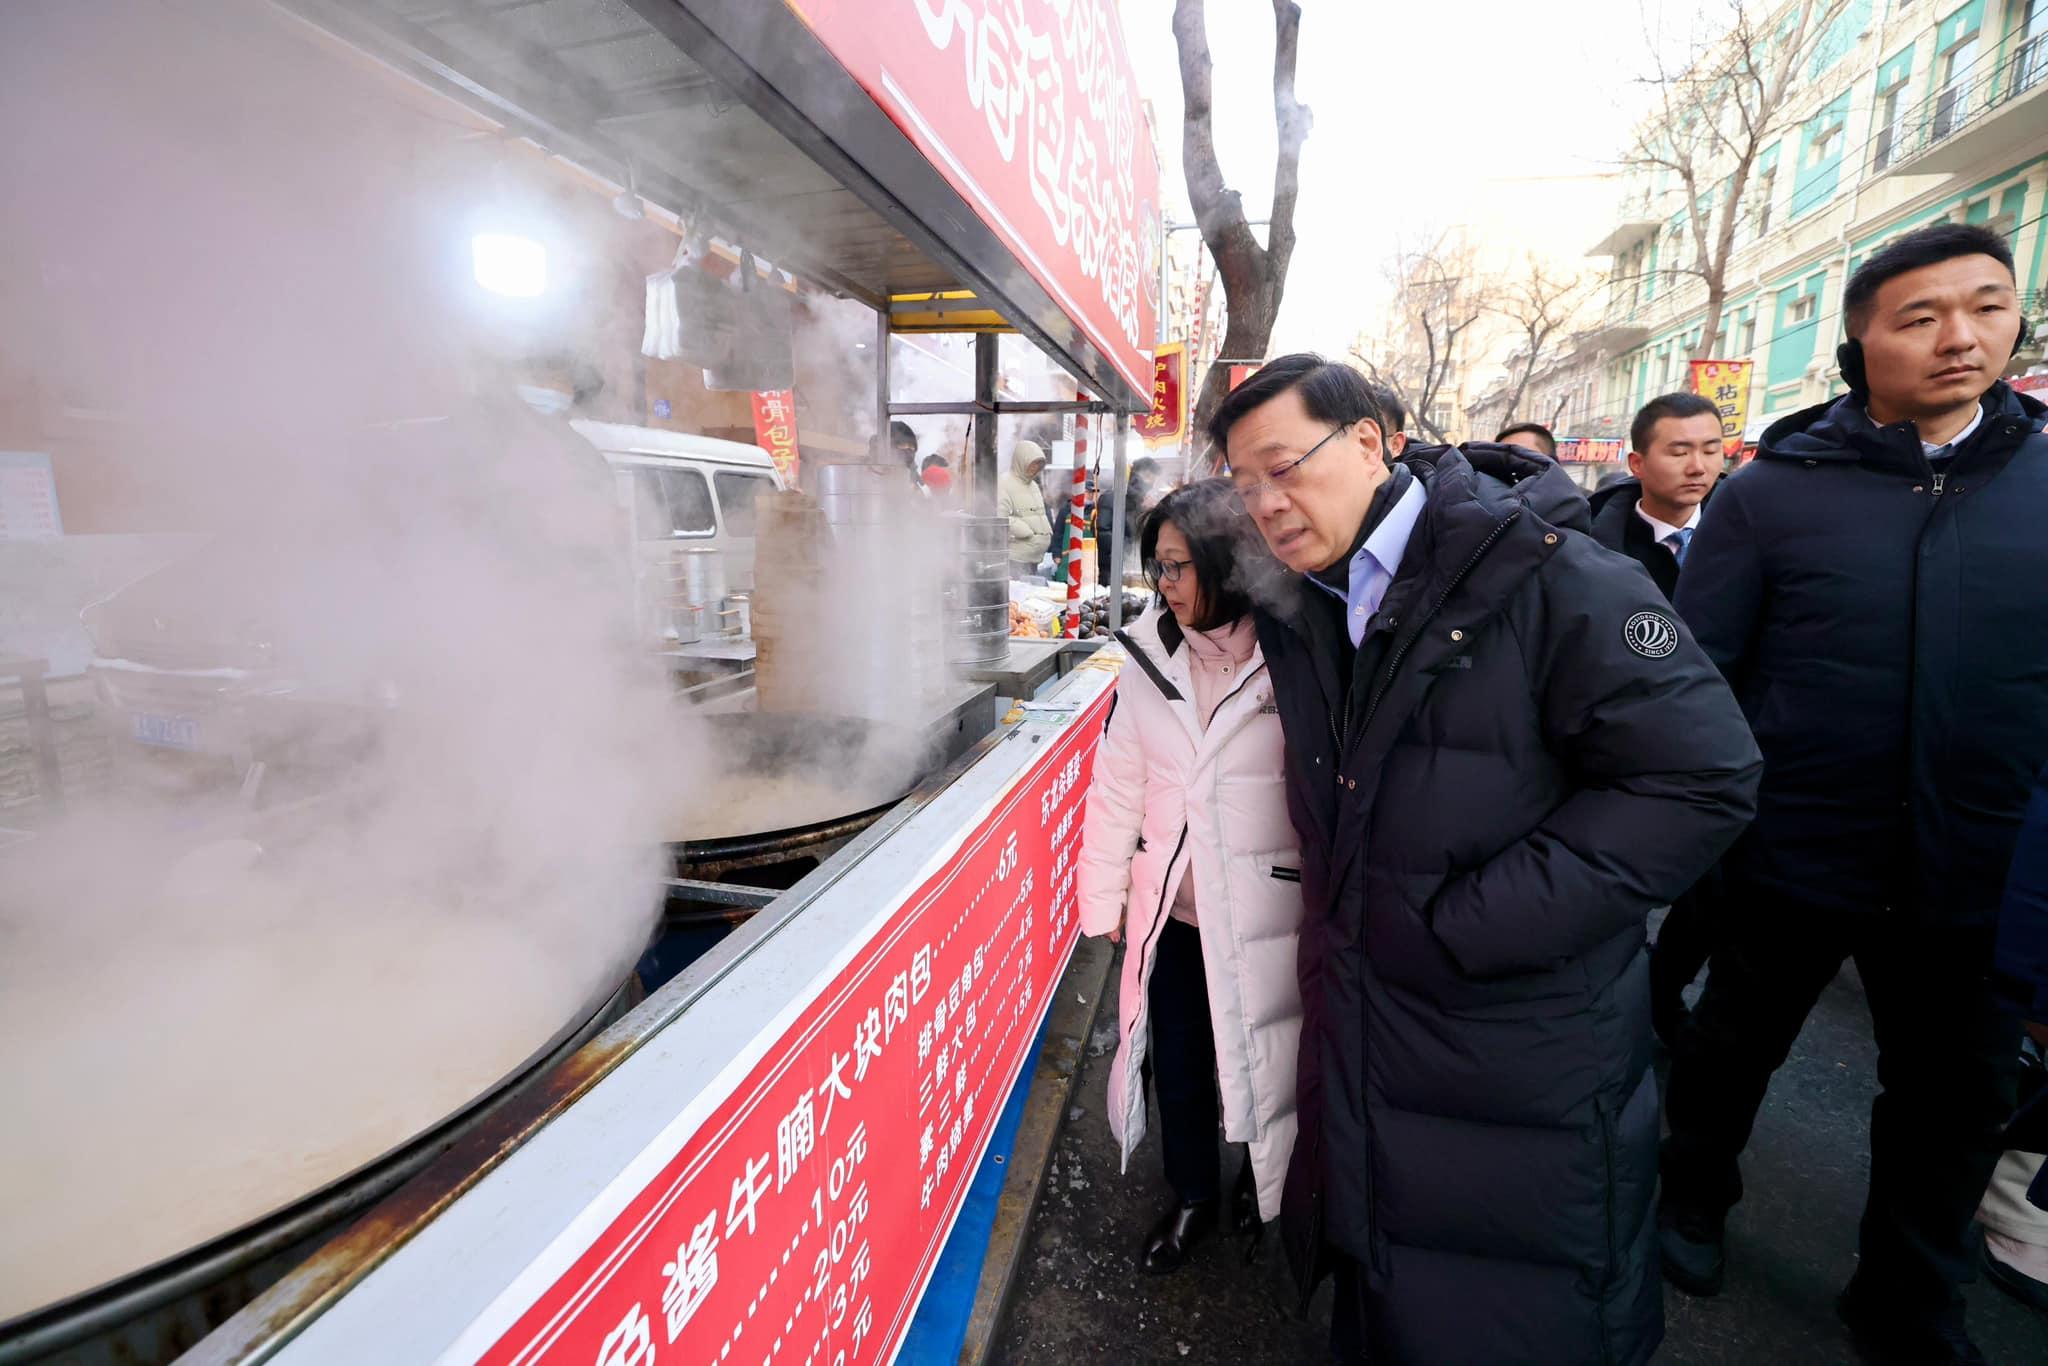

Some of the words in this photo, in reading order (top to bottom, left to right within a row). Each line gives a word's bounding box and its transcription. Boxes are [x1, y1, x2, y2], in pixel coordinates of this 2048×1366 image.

[758, 390, 796, 473] 骨包子
[1715, 384, 1742, 438] 粘豆包
[999, 830, 1018, 881] 6元
[918, 943, 984, 1069] 排骨豆角包
[1021, 867, 1033, 903] 5元
[1018, 940, 1033, 984] 2元
[919, 1000, 976, 1119] 三鲜大包
[1019, 904, 1033, 940] 4元
[812, 1120, 867, 1228] 10元
[813, 1179, 869, 1301] 20元
[832, 1238, 871, 1330] 3元
